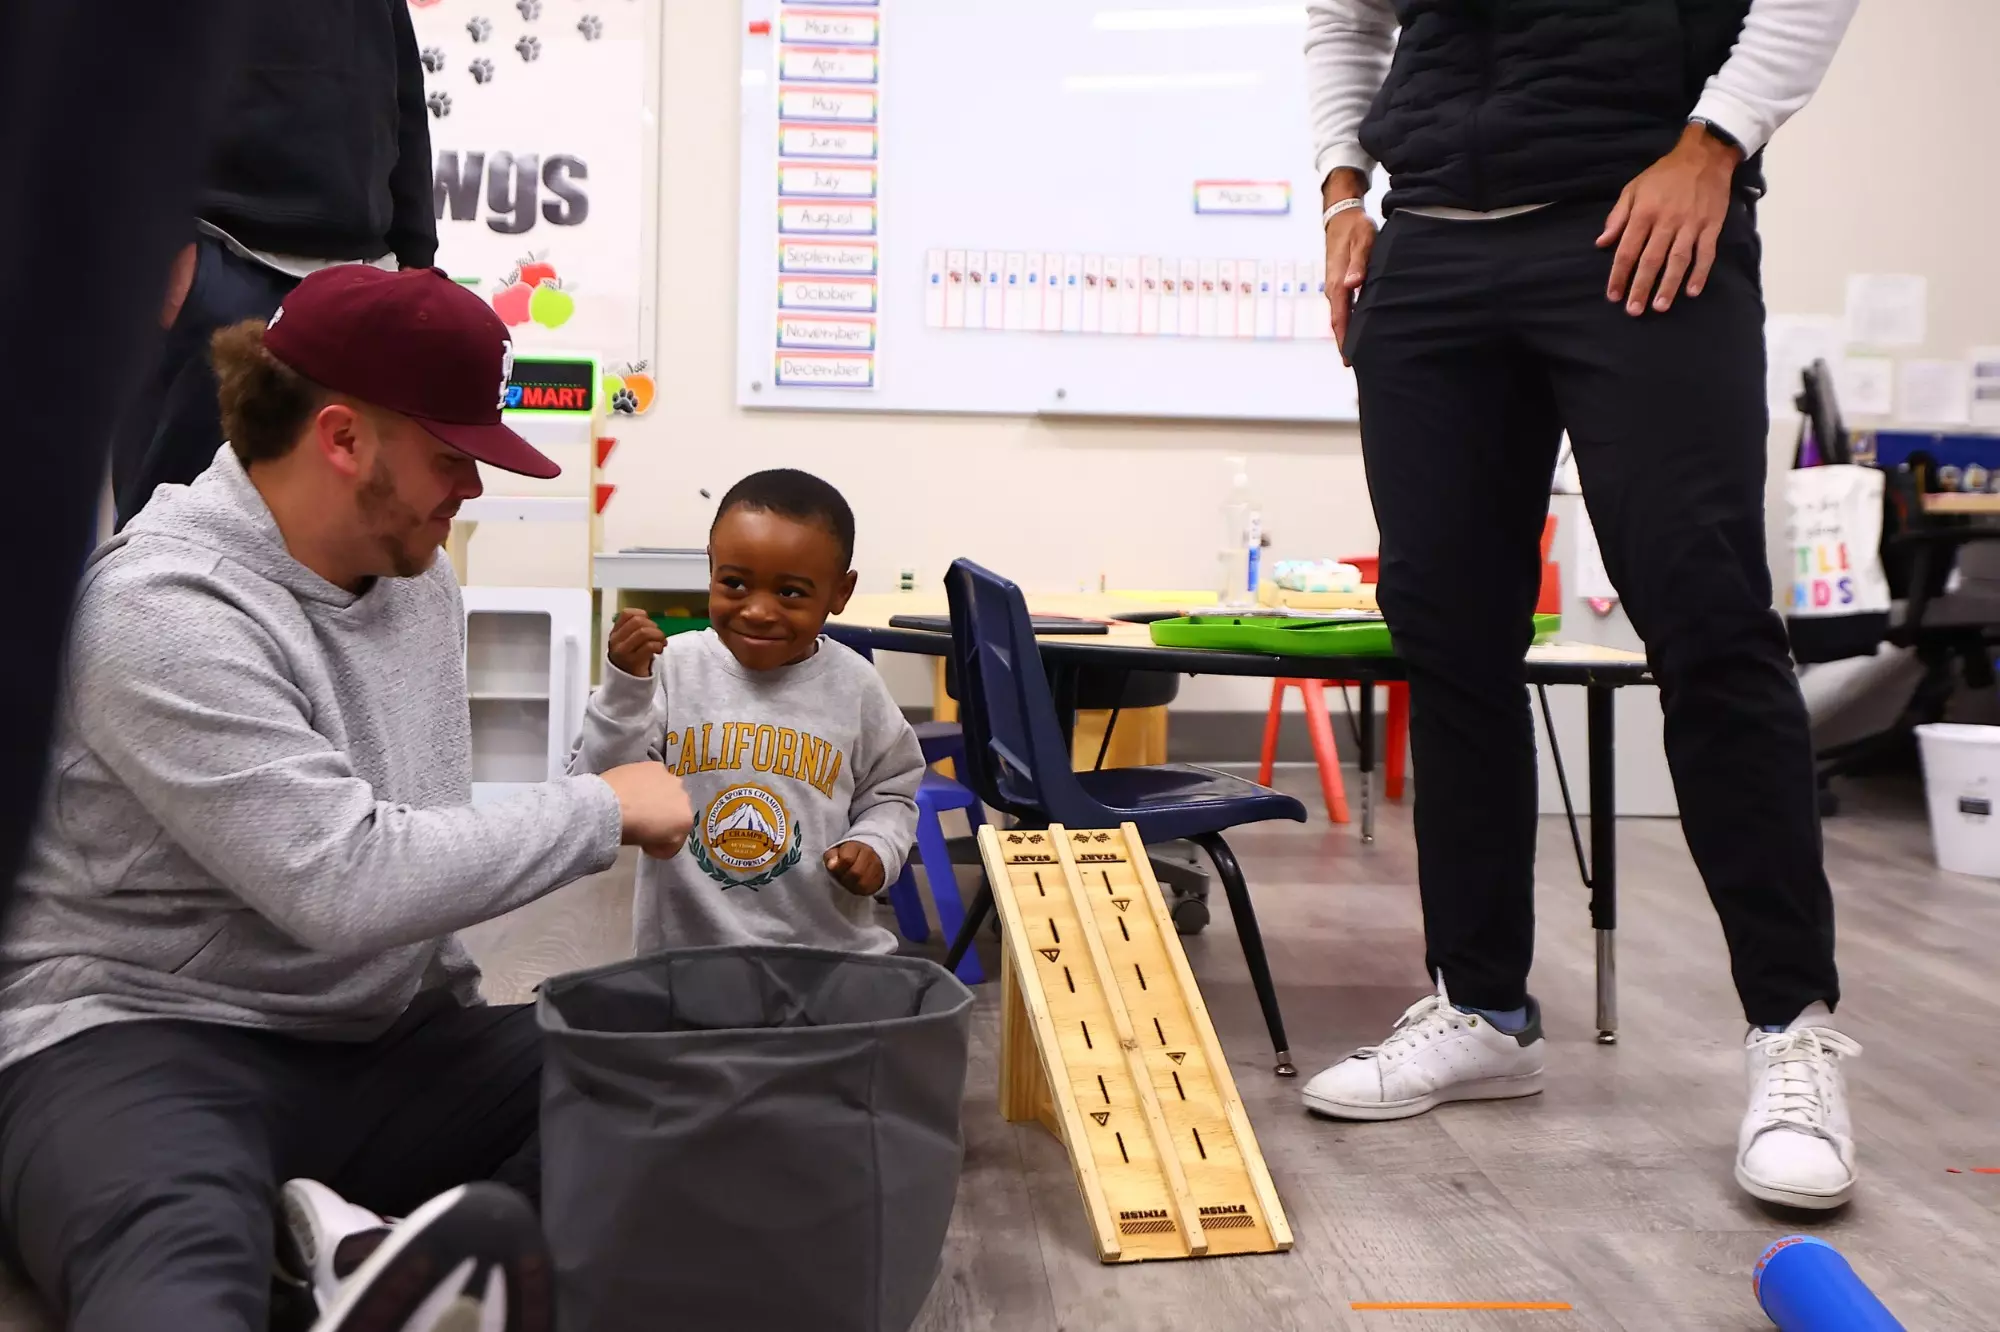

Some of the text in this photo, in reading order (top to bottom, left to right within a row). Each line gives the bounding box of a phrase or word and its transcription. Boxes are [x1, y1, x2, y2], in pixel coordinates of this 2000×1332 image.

[812, 96, 843, 115] May
[809, 132, 847, 149] June
[814, 172, 841, 191] July
[800, 209, 854, 228] August
[787, 247, 867, 267] September
[795, 284, 858, 302] October
[786, 323, 864, 340] November
[784, 359, 863, 377] December
[522, 386, 587, 409] MART
[666, 722, 843, 800] CALIFORNIA
[707, 788, 785, 840] OUTDOOR SPORTS CHAMPIONSHIP
[729, 830, 762, 840] CHAMPS
[721, 853, 766, 867] CALIFORNIA
[1013, 854, 1051, 862] START
[1080, 853, 1118, 861] START
[1119, 1208, 1168, 1220] FINISH
[1199, 1204, 1247, 1216] FINISH
